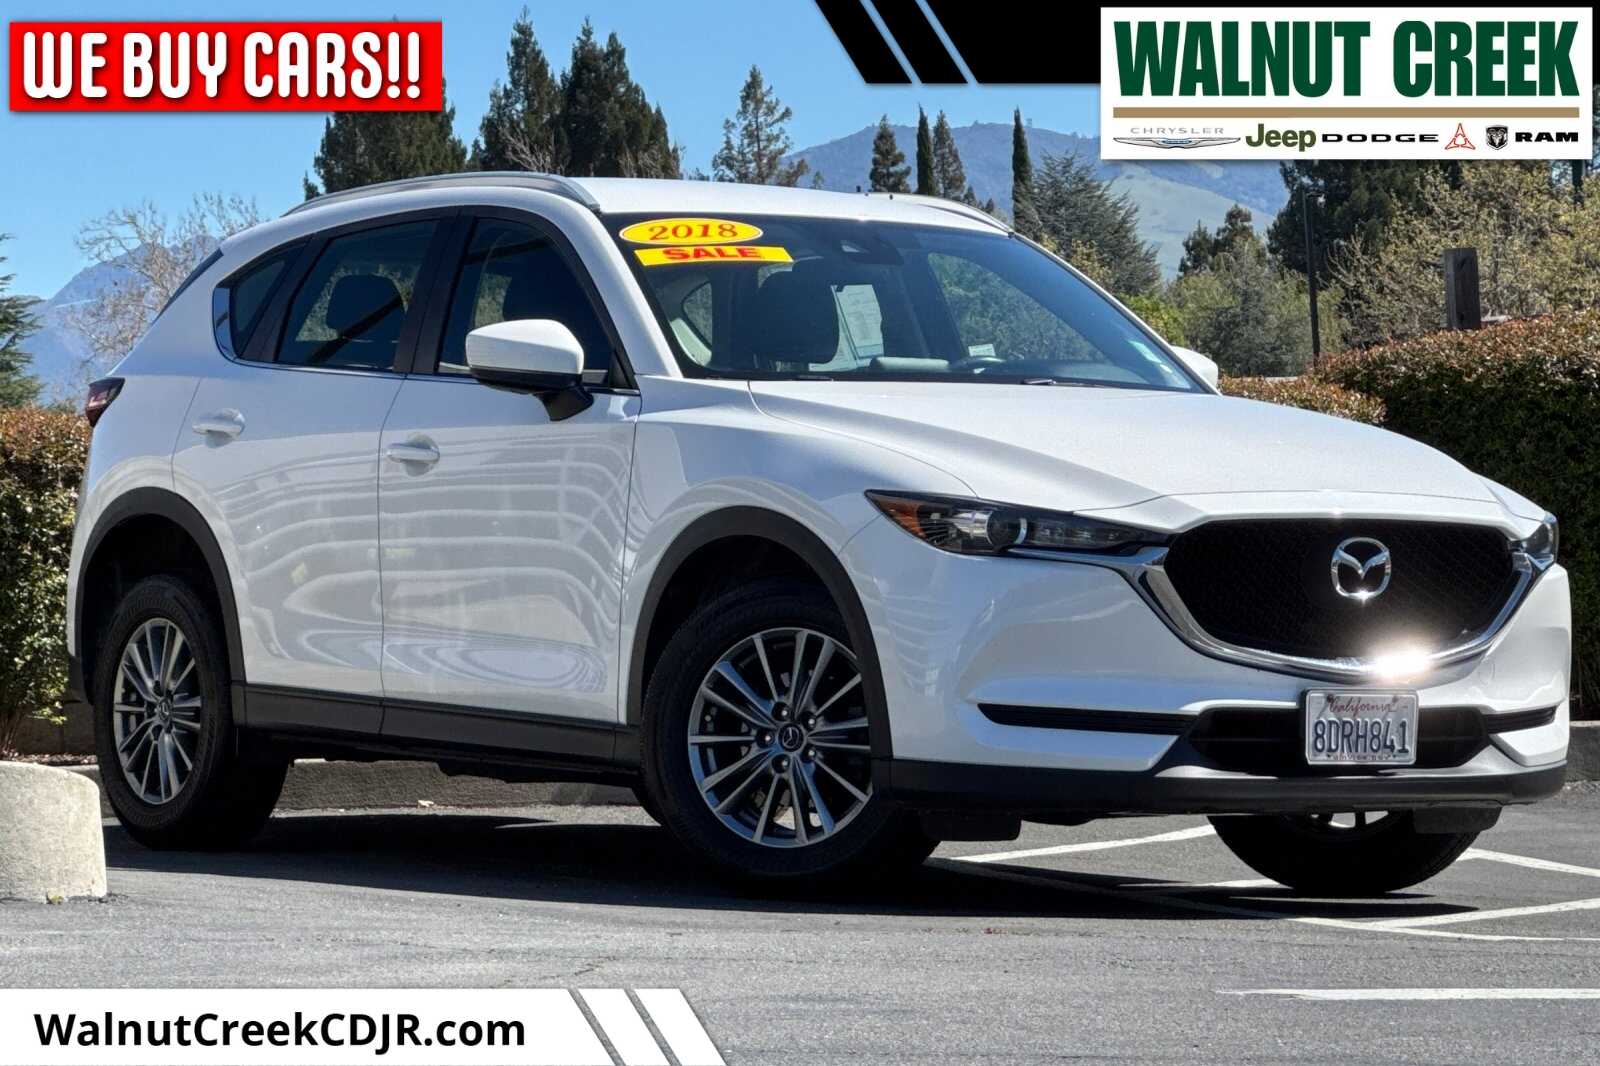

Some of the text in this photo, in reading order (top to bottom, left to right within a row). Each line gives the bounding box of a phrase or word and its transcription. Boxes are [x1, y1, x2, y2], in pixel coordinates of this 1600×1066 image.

[649, 224, 738, 240] 2018
[663, 247, 760, 260] SALE
[1314, 719, 1409, 754] 8DRH841
